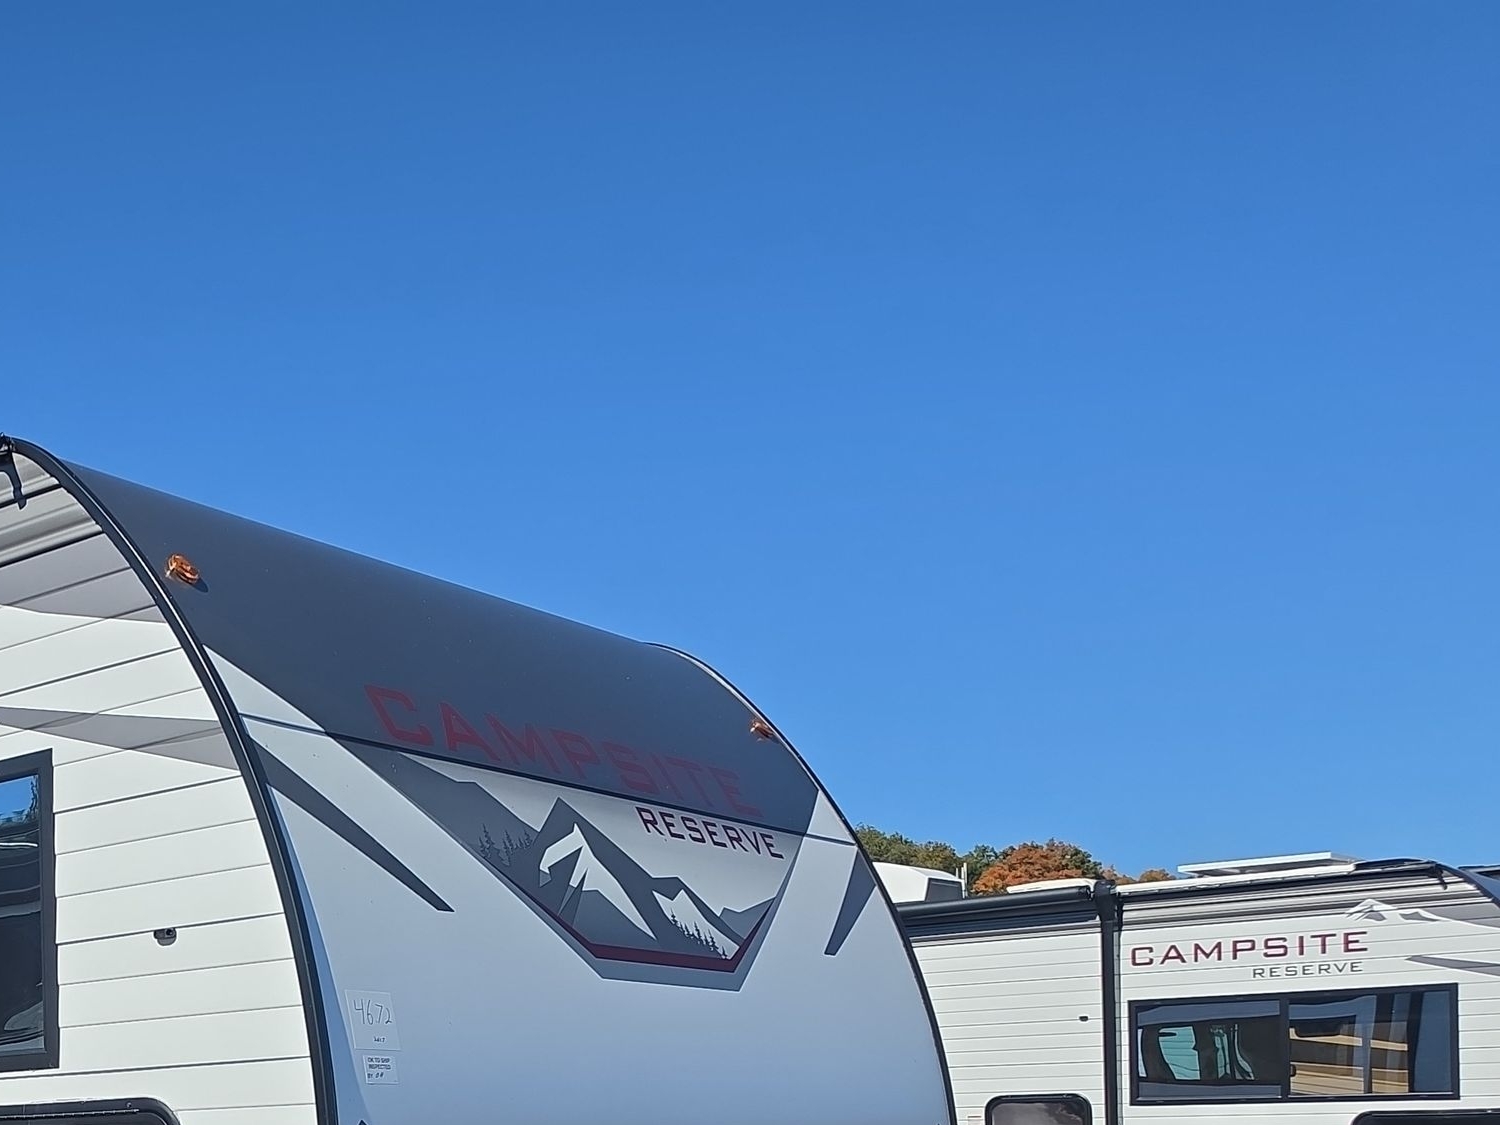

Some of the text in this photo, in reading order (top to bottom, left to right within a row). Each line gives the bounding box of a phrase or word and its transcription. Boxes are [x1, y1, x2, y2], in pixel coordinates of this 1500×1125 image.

[364, 684, 763, 818] CAMPSITE
[635, 806, 784, 860] RESERVE
[1131, 931, 1368, 966] CAMPSITE
[1252, 961, 1363, 979] RESERVE
[353, 999, 392, 1025] 4672
